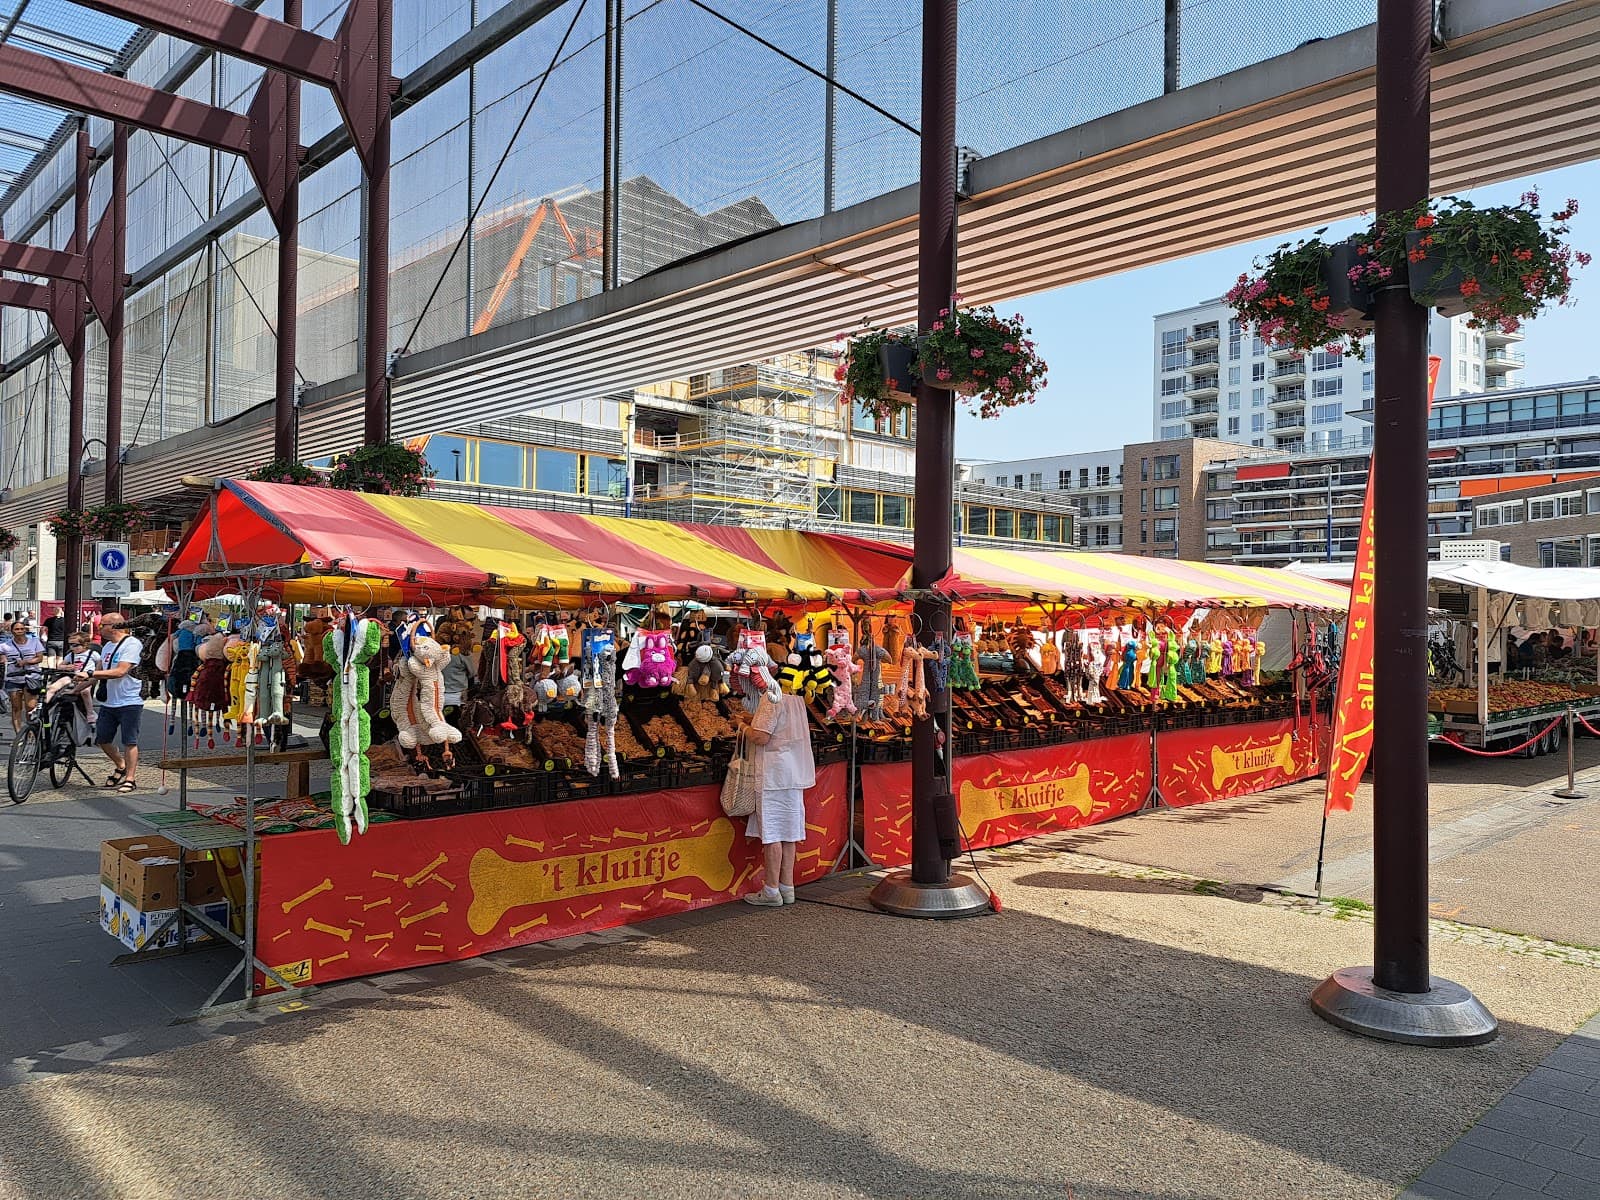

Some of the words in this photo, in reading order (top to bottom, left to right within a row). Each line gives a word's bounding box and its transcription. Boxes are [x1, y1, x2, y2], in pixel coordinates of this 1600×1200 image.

[1243, 748, 1276, 769] kluifje
[1010, 783, 1065, 808] kluifje
[575, 846, 681, 888] kluifje
